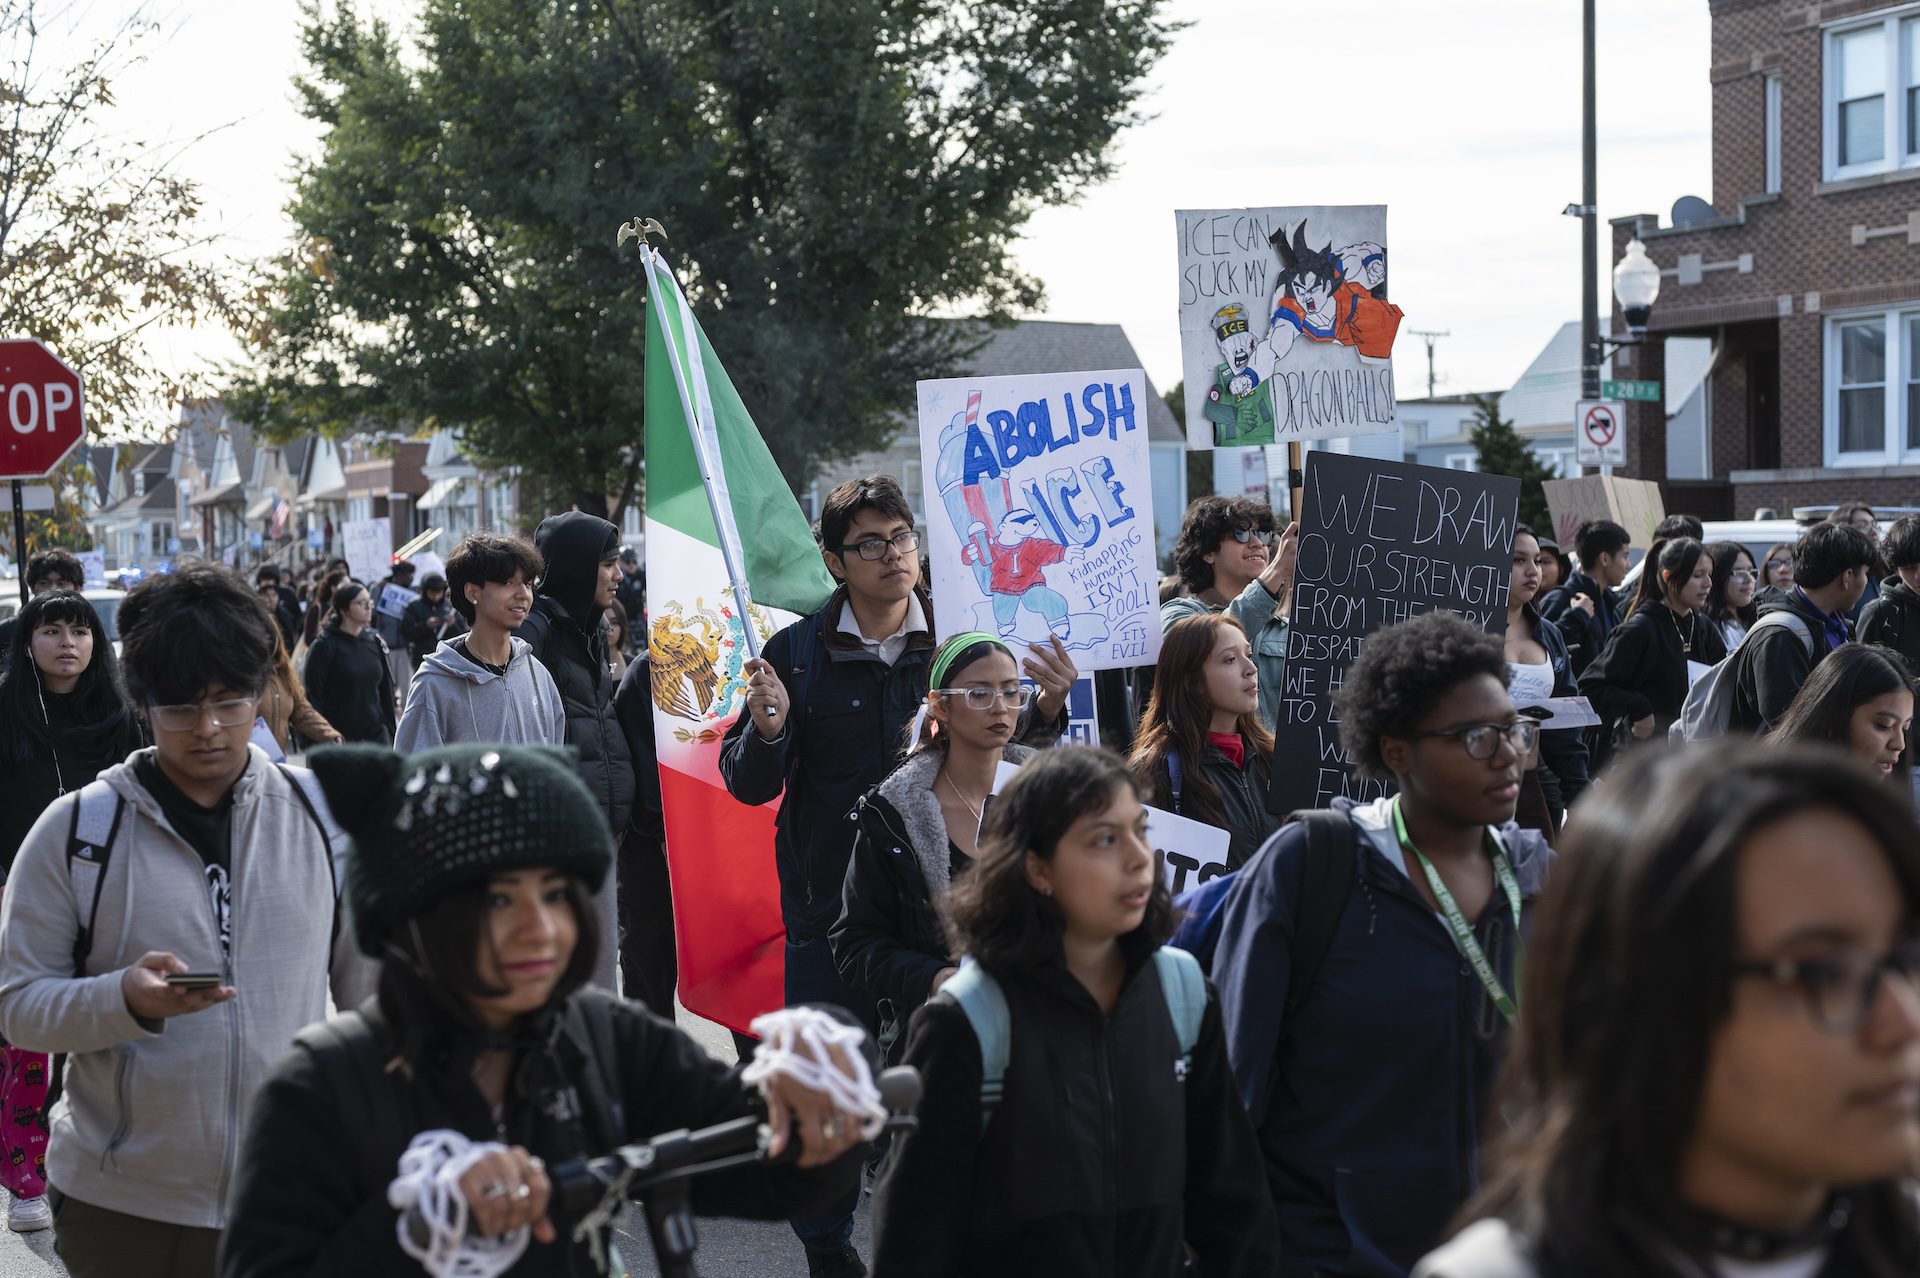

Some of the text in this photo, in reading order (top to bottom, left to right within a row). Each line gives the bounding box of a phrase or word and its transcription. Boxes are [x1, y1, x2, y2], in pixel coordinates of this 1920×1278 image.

[1184, 214, 1272, 256] ICE CAN
[1183, 258, 1267, 306] SUCK MY
[1221, 321, 1245, 337] ICE
[0, 382, 74, 434] OP
[963, 382, 1136, 486] ABOLISH
[1019, 455, 1135, 548] ICE
[1313, 463, 1403, 543] WE
[1412, 479, 1519, 555] DRAW
[1083, 567, 1140, 611] ISN'T
[1296, 533, 1513, 608] OUR STRENGTH
[1106, 582, 1151, 623] COOL!
[1294, 583, 1367, 630] FROM
[1111, 642, 1149, 660] EVIL
[1289, 630, 1366, 661] DESPAI
[1286, 664, 1316, 697] WE
[1282, 698, 1317, 724] TO
